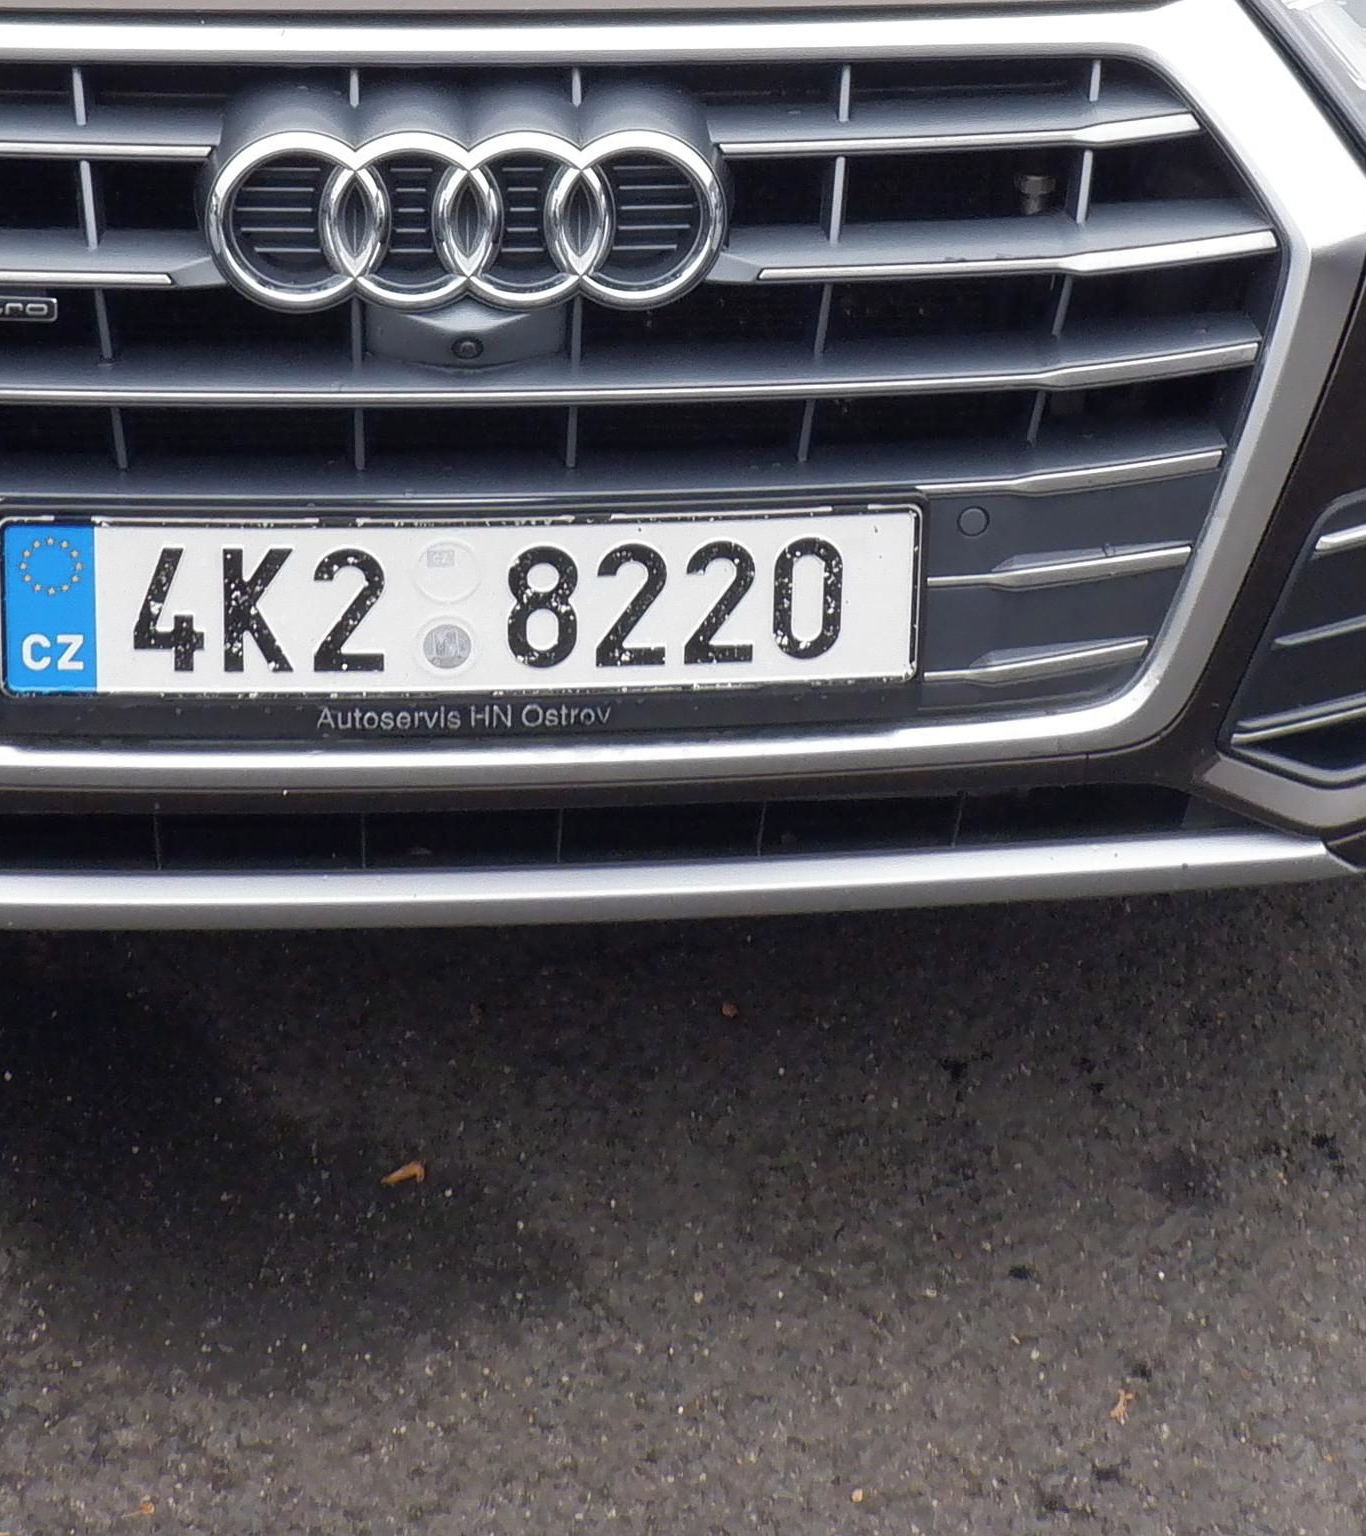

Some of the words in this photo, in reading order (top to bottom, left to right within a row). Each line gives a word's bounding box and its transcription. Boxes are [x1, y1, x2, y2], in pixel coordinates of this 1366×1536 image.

[134, 547, 386, 673] 4K2
[507, 536, 844, 669] 8220
[22, 634, 85, 671] CZ
[316, 706, 462, 730] Autoservis
[471, 705, 512, 728] HN
[521, 703, 613, 728] Ostrov
